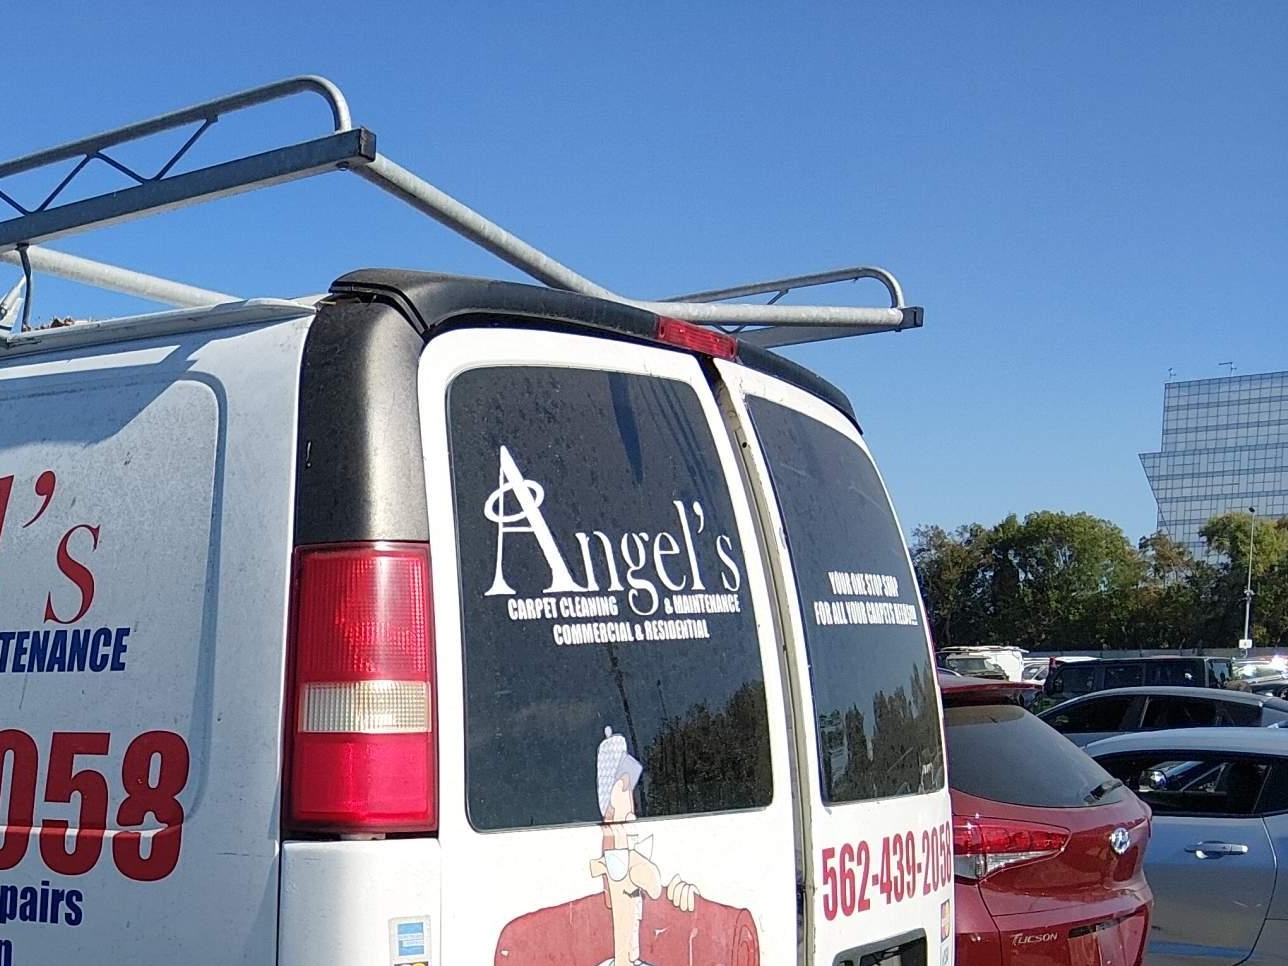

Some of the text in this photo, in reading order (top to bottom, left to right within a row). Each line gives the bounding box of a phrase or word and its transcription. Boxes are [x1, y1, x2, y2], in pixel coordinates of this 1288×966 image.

[483, 445, 742, 617] Angel's
[507, 596, 619, 621] CARPET CLEANING
[664, 593, 741, 615] & MAINTENANCE
[813, 601, 833, 626] FOR
[552, 619, 710, 646] COMMERCIAL & RESIDENTIAL
[822, 821, 952, 921] 562-439-2058
